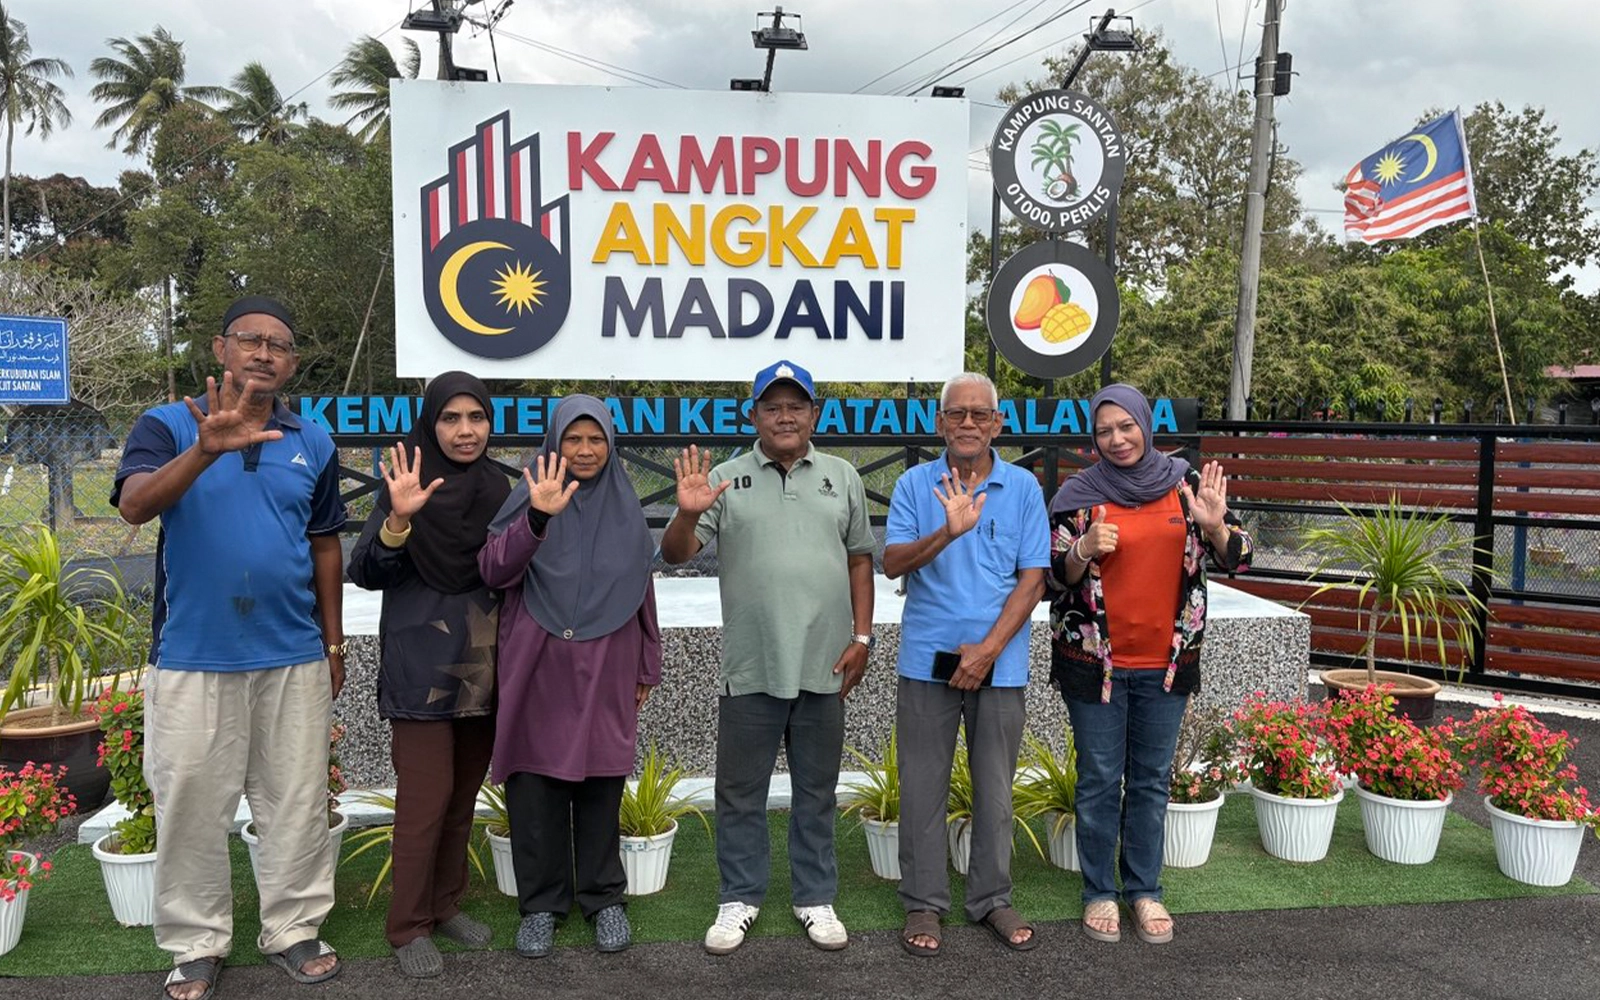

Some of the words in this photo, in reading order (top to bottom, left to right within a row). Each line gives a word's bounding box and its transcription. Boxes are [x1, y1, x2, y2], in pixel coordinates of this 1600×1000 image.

[998, 95, 1070, 152] KAMPUNG
[1072, 99, 1120, 158] SANTAN
[567, 131, 937, 199] KAMPUNG
[1006, 183, 1055, 228] 01000,
[1060, 185, 1111, 227] PERLIS
[591, 202, 916, 269] ANGKAT
[601, 276, 905, 340] MADANI
[12, 381, 41, 391] SANTAN
[40, 370, 61, 379] ISLAM
[300, 396, 665, 433] KEMTEAN
[680, 397, 937, 433] KESATAN
[733, 475, 752, 490] 10
